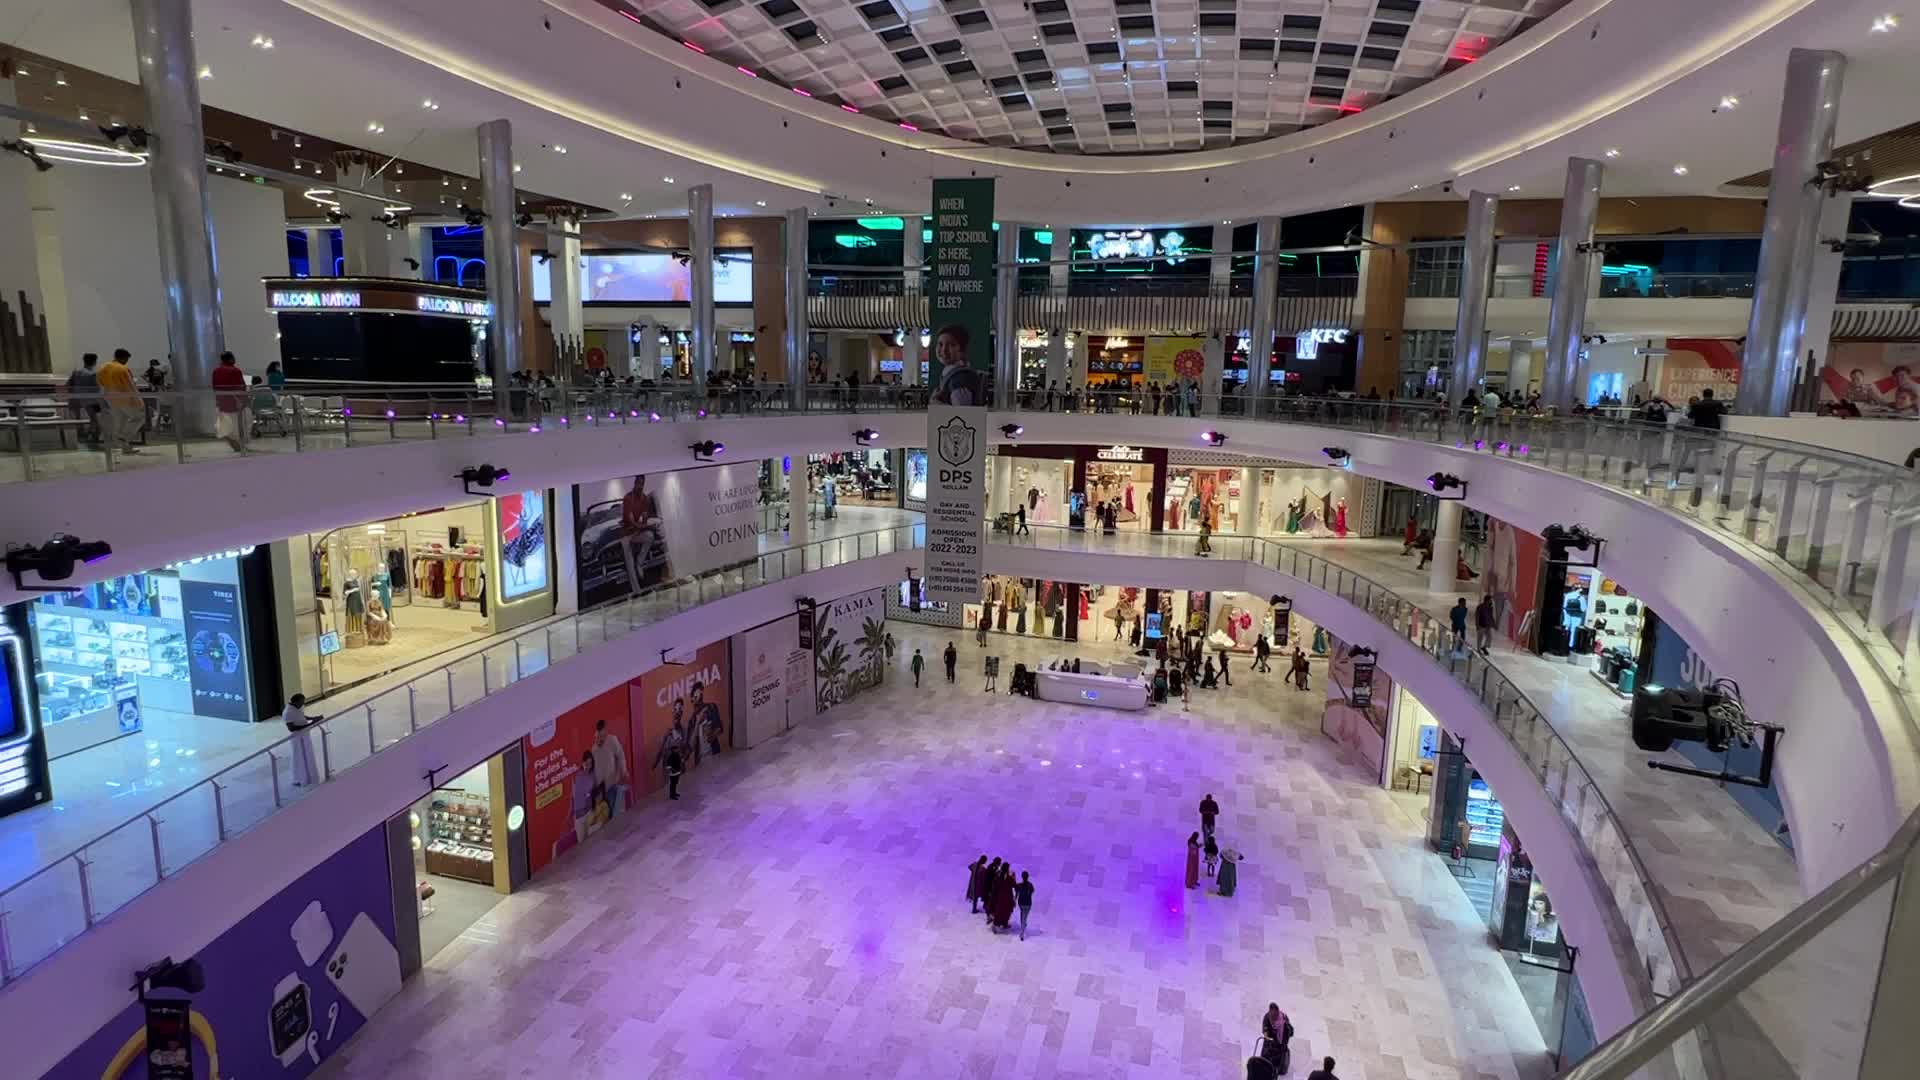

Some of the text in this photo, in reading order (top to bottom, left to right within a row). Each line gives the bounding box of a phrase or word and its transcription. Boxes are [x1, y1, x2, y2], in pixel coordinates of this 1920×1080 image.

[940, 198, 965, 210] WHEN
[939, 214, 968, 226] INDIA'S
[939, 231, 988, 243] TOP SCHOOL
[938, 247, 947, 259] IS
[938, 263, 970, 276] WHY GO
[937, 280, 984, 292] ANYWHERE
[273, 293, 360, 307] FALOODA NATION
[418, 297, 463, 313] FALOODA
[937, 296, 962, 308] ELSE?
[1310, 328, 1349, 343] KFC
[1671, 367, 1739, 381] EXPERIENCE
[1097, 451, 1143, 460] CELEBRATE
[940, 470, 973, 484] DPS
[933, 508, 976, 517] RESIDENTIAL
[931, 529, 976, 537] ADMISSIONS
[930, 543, 976, 554] 2022-2023
[834, 598, 873, 616] KAMA
[657, 664, 721, 706] CINEMA
[752, 678, 781, 699] OPENING
[752, 694, 771, 709] SOON
[535, 748, 564, 768] For the
[536, 761, 561, 782] styles
[536, 778, 550, 795] the
